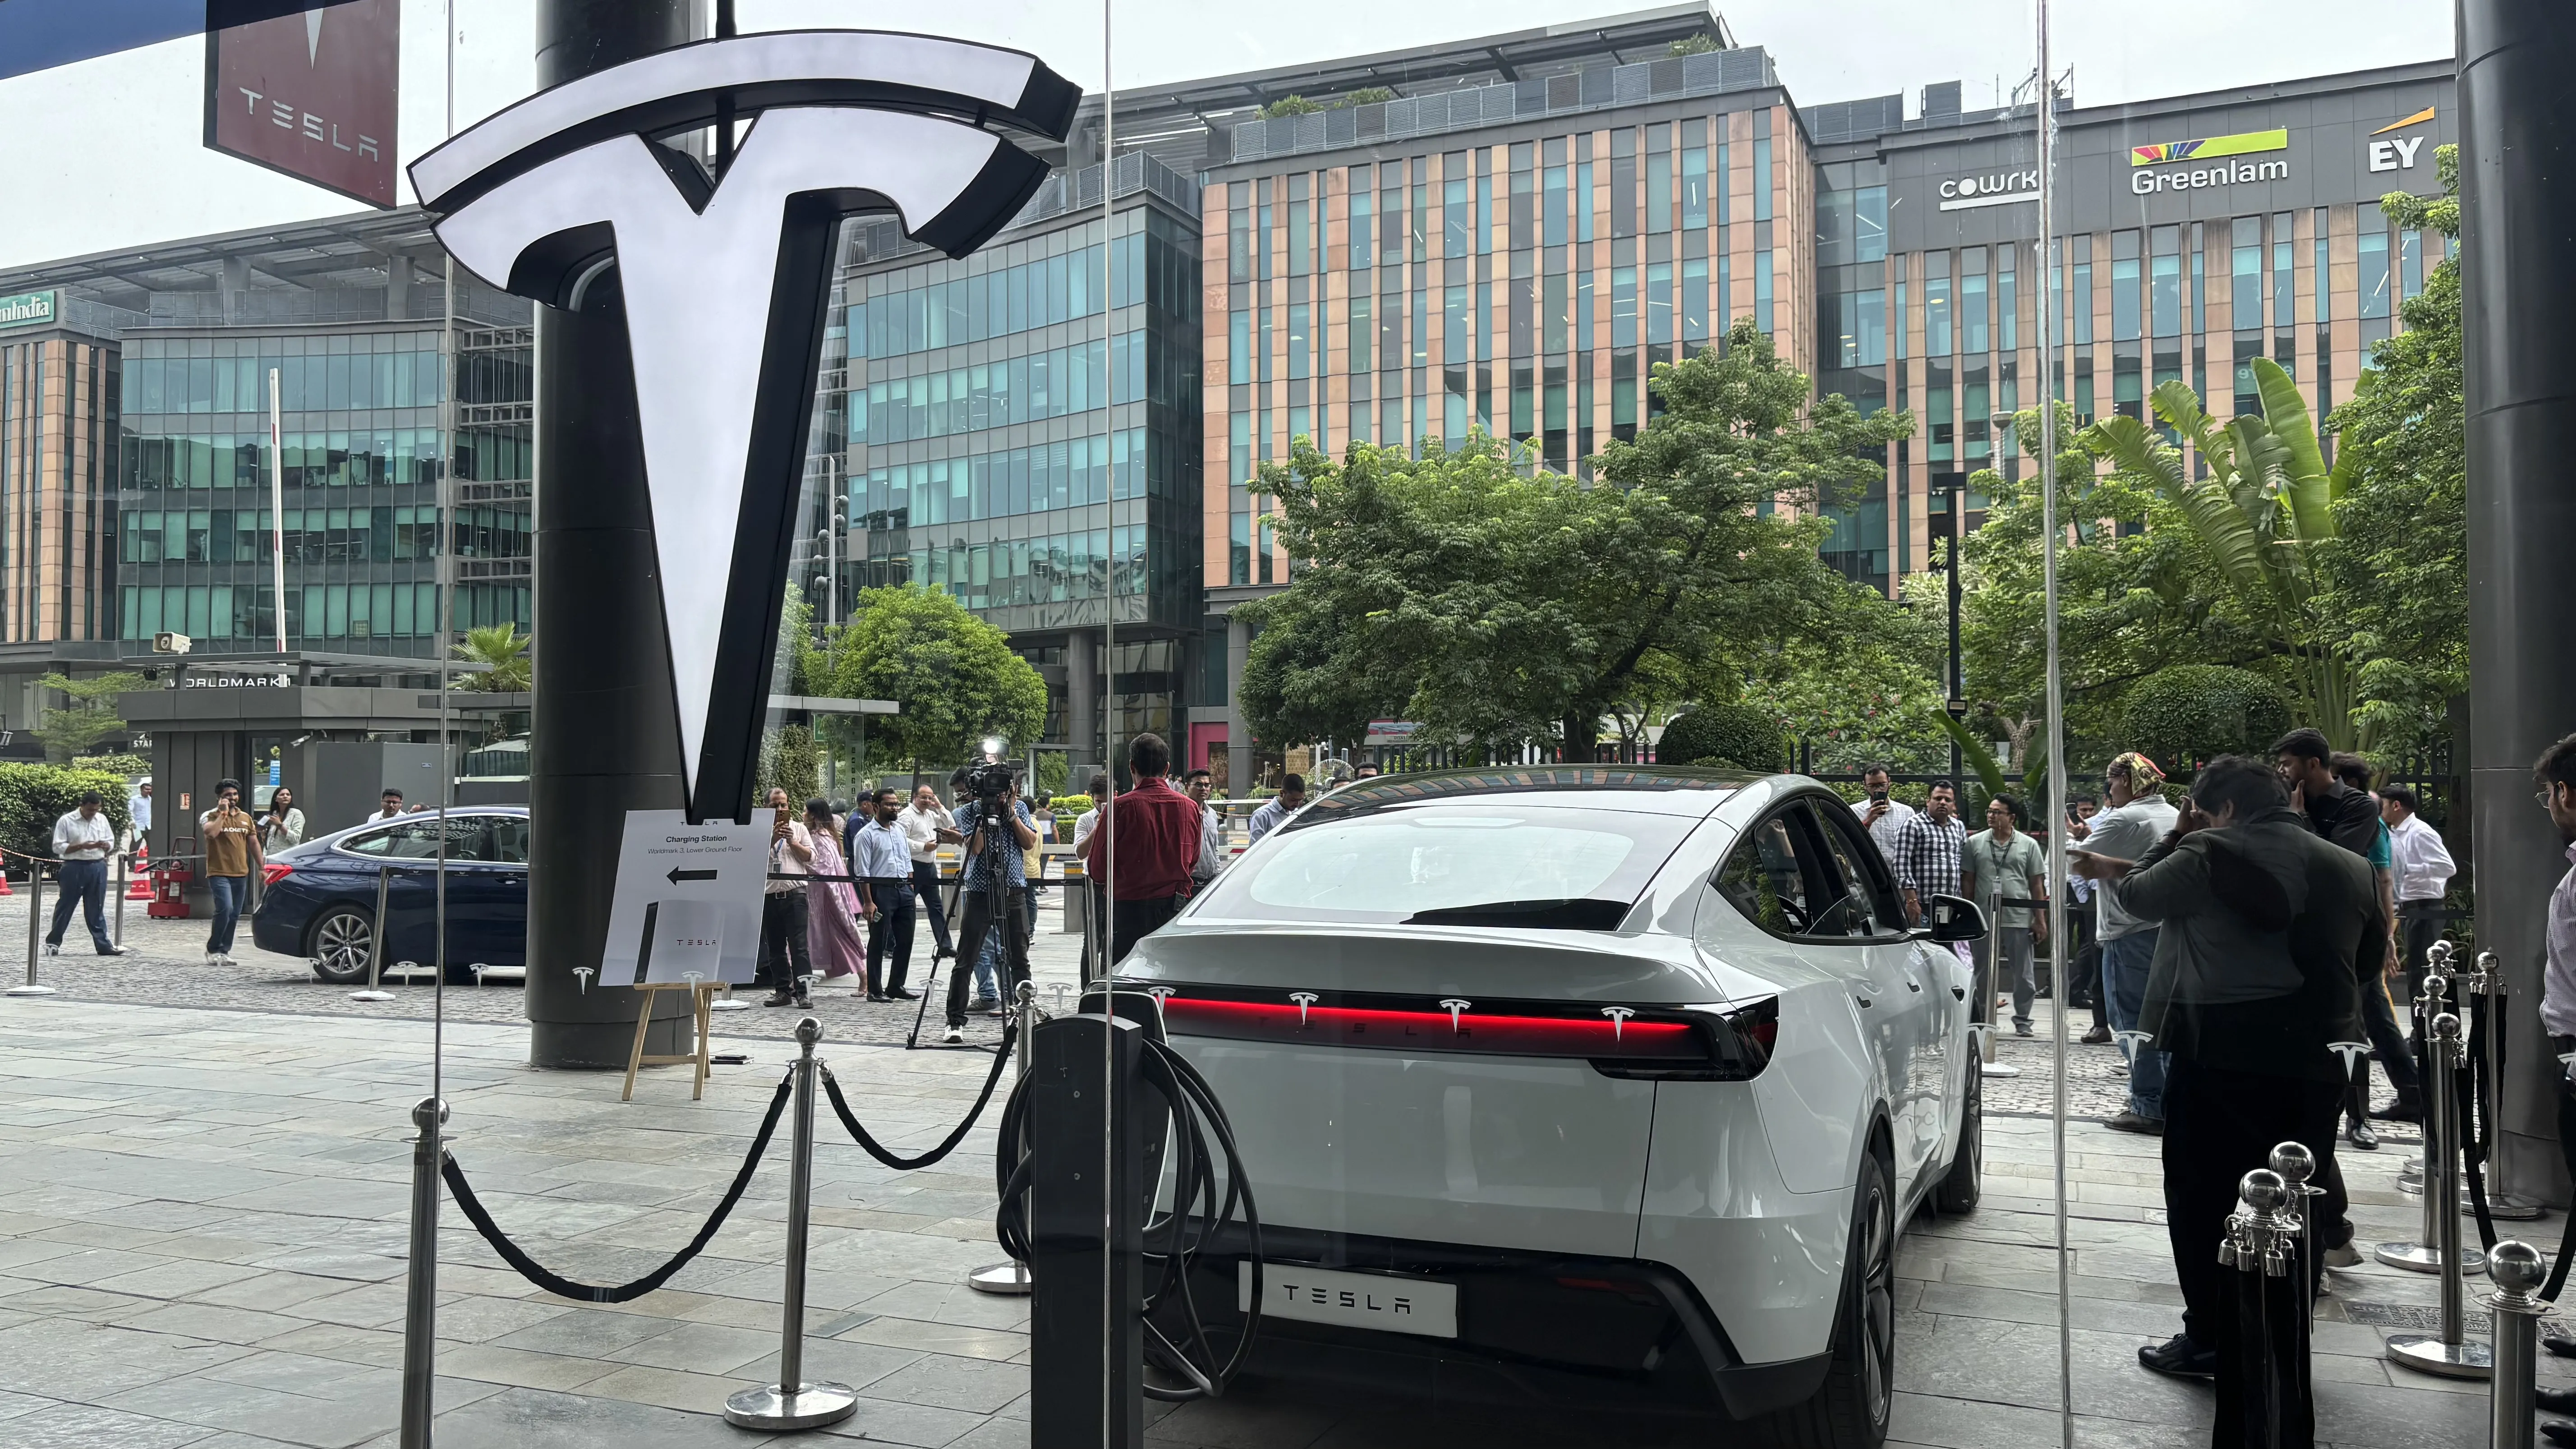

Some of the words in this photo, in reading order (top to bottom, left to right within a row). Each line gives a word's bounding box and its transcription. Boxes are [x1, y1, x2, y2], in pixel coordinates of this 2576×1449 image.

[239, 87, 378, 162] TESLA
[2369, 136, 2424, 172] EY
[2131, 159, 2288, 195] Greenlam
[0, 296, 50, 322] nIndia
[666, 836, 700, 844] Charging
[1282, 1284, 1411, 1315] TESLA
